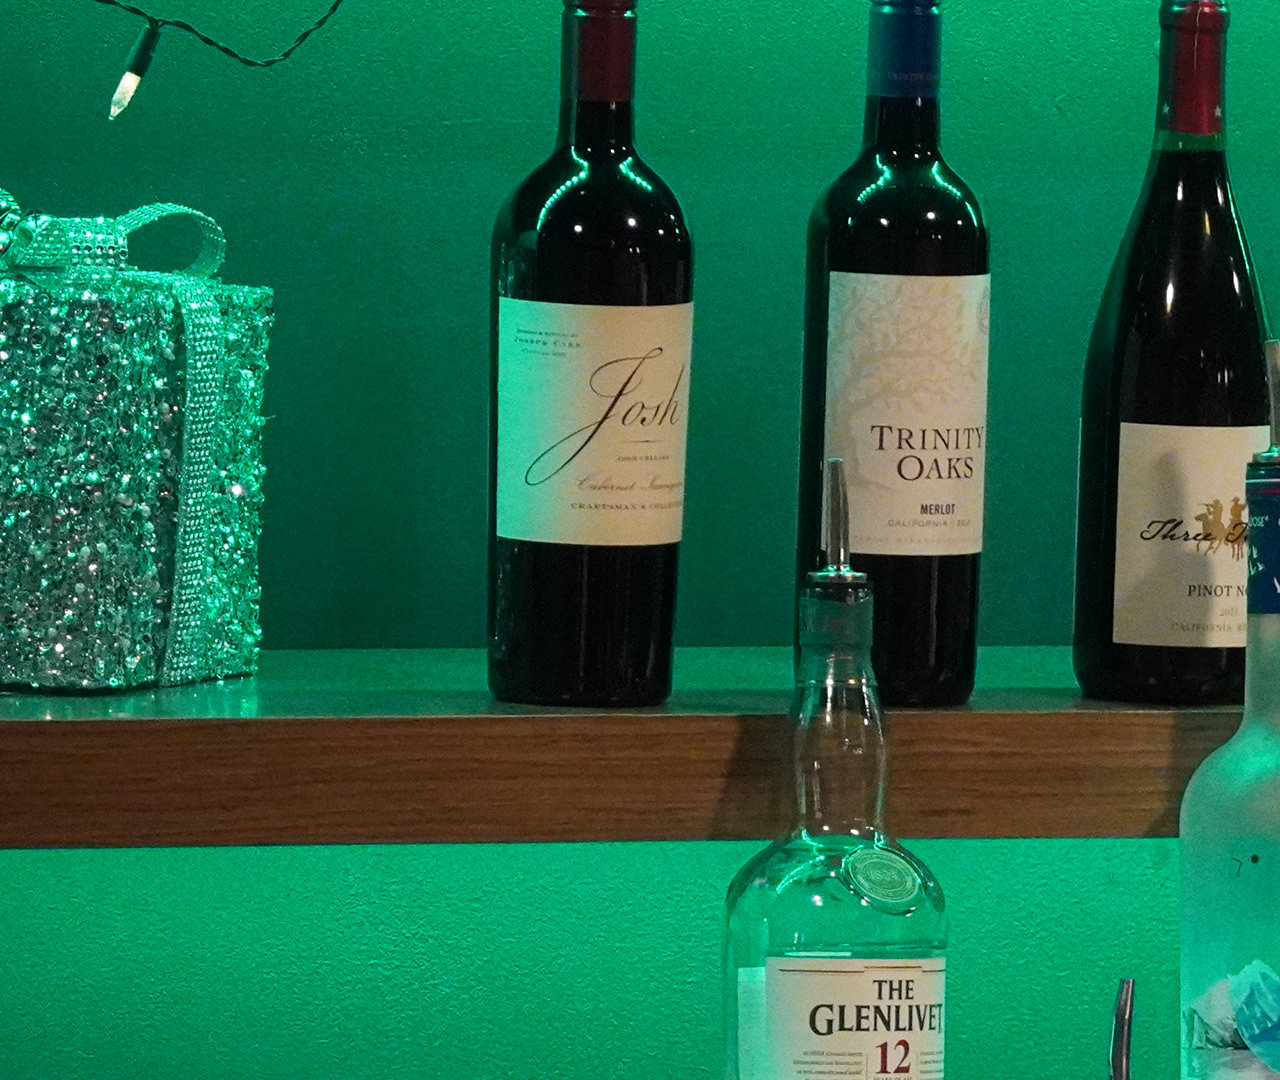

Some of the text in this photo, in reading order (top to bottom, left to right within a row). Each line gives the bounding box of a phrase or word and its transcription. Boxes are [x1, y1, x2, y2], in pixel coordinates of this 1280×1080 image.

[525, 347, 685, 486] Josh
[871, 425, 984, 450] TRINITY
[897, 455, 974, 481] OAKS
[920, 504, 955, 515] MERLOT
[1140, 518, 1215, 543] Three
[1187, 584, 1233, 598] PINOT
[873, 979, 914, 1001] THE
[809, 1003, 943, 1036] GLENLIVET
[875, 1038, 912, 1075] 12
